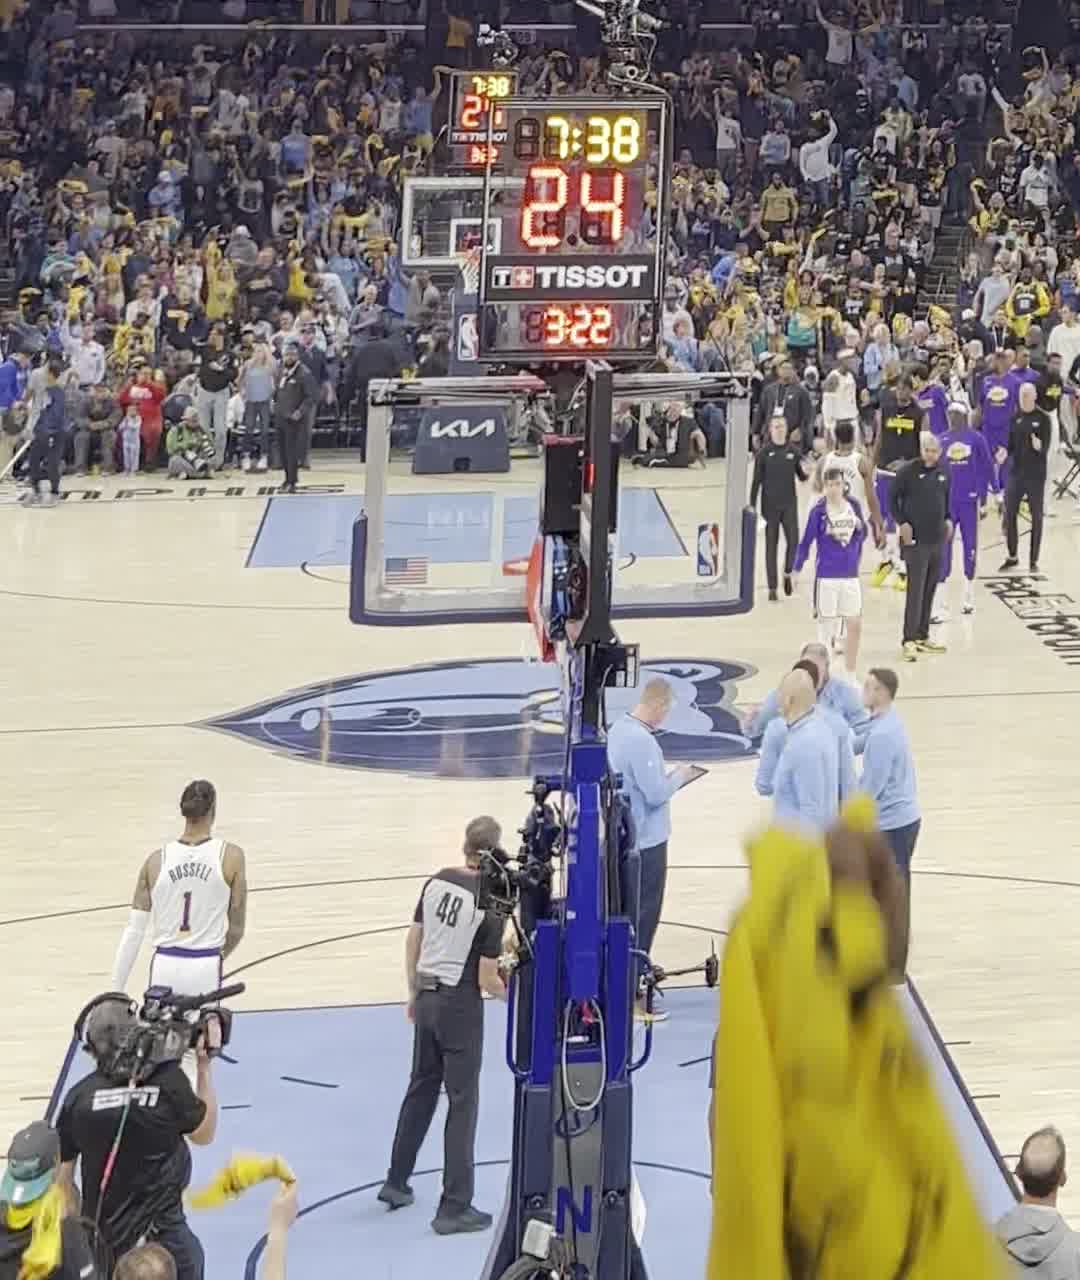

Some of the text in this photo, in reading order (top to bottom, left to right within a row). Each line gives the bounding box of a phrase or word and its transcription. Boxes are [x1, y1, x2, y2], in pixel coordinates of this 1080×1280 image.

[471, 76, 510, 97] 7:38
[547, 116, 640, 164] 7:38
[521, 167, 624, 247] 24
[537, 265, 648, 288] TISSOT
[544, 308, 611, 345] 3:22
[430, 418, 496, 438] KIA
[167, 861, 213, 883] RUSSELL
[179, 890, 192, 932] 1
[436, 892, 464, 928] 48
